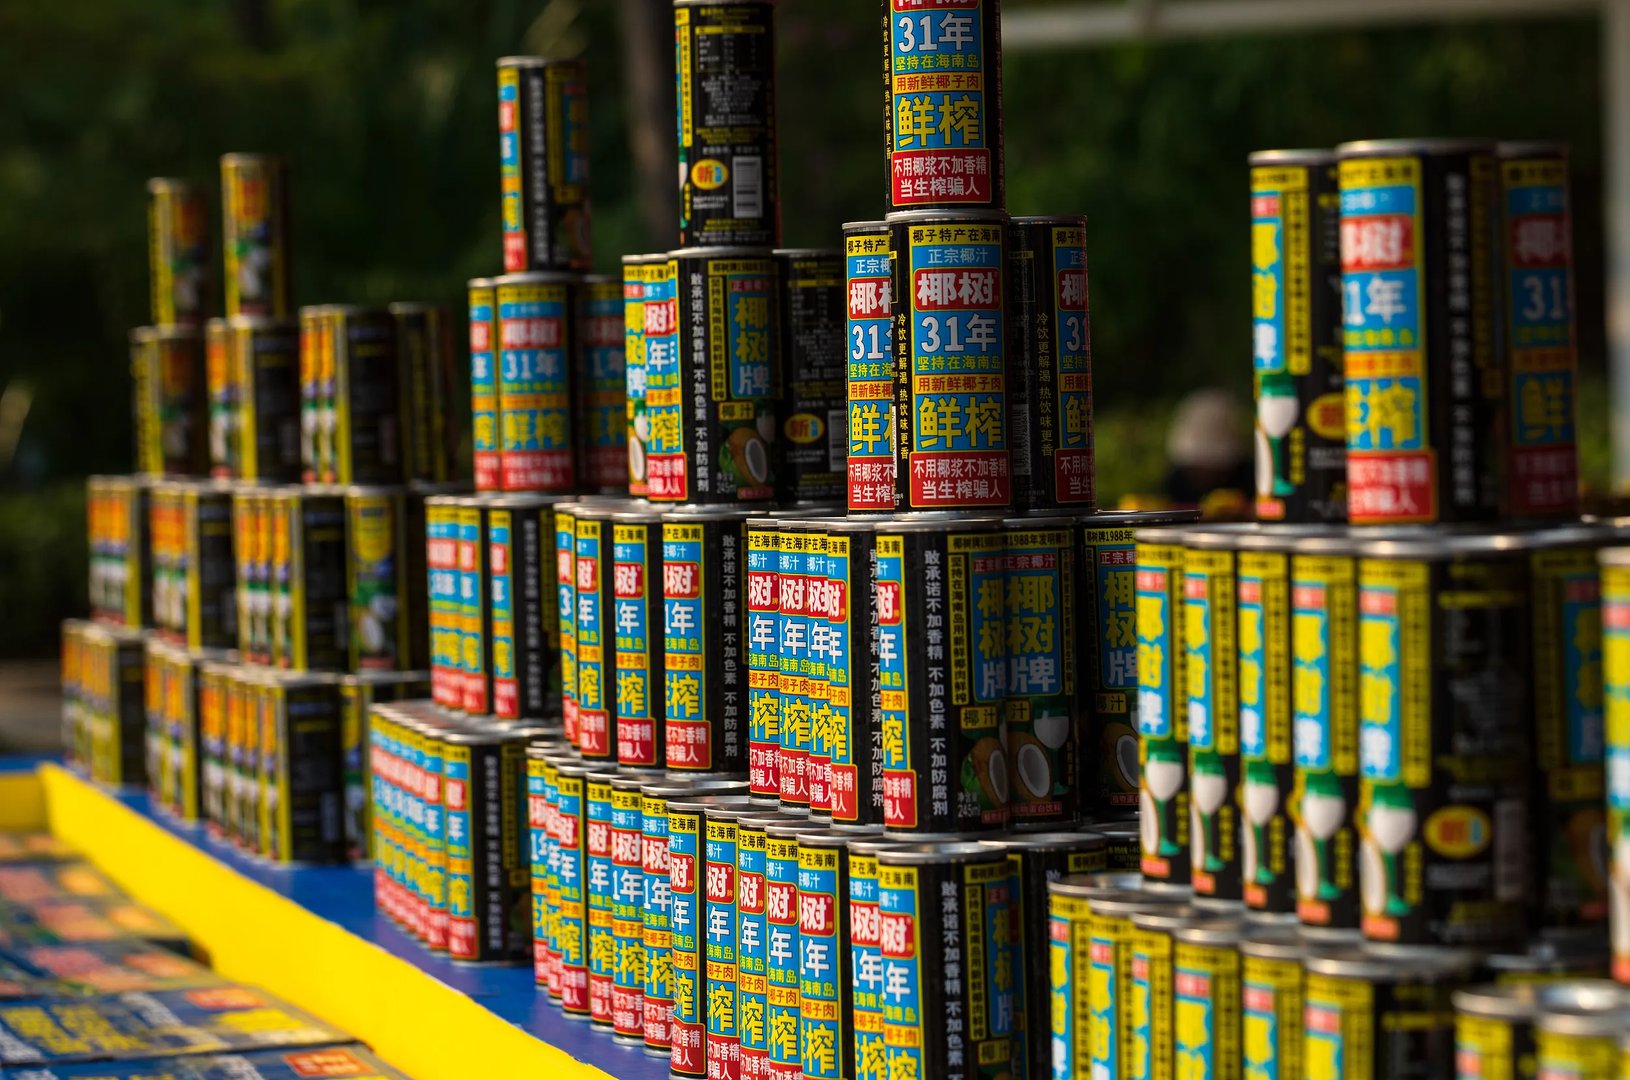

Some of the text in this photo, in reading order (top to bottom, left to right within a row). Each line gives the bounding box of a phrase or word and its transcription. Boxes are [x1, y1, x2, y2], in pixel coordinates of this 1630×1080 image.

[898, 12, 974, 53] 31年
[895, 54, 979, 71] 坚持在海南岛
[896, 74, 979, 92] 用新鲜椰子肉
[897, 94, 981, 147] 鲜榨
[894, 155, 987, 177] 不用椰浆不加香精
[900, 176, 981, 198] 当生榨骗人
[912, 227, 1001, 244] 椰子特产在海南
[928, 247, 988, 264] 正宗椰汁
[917, 271, 995, 306] 椰树
[920, 313, 997, 353] 31年
[917, 355, 1001, 372] 坚持在海南岛
[918, 373, 1001, 392] 用新鲜椰子肉
[918, 395, 1001, 449] 鲜榨
[913, 458, 1008, 479] 不用椰浆不加香精
[922, 479, 1002, 500] 当生榨骗人
[1007, 574, 1056, 694] 椰树牌
[925, 550, 949, 817] 敢承诺不加香精 不加色素 不加防腐剂
